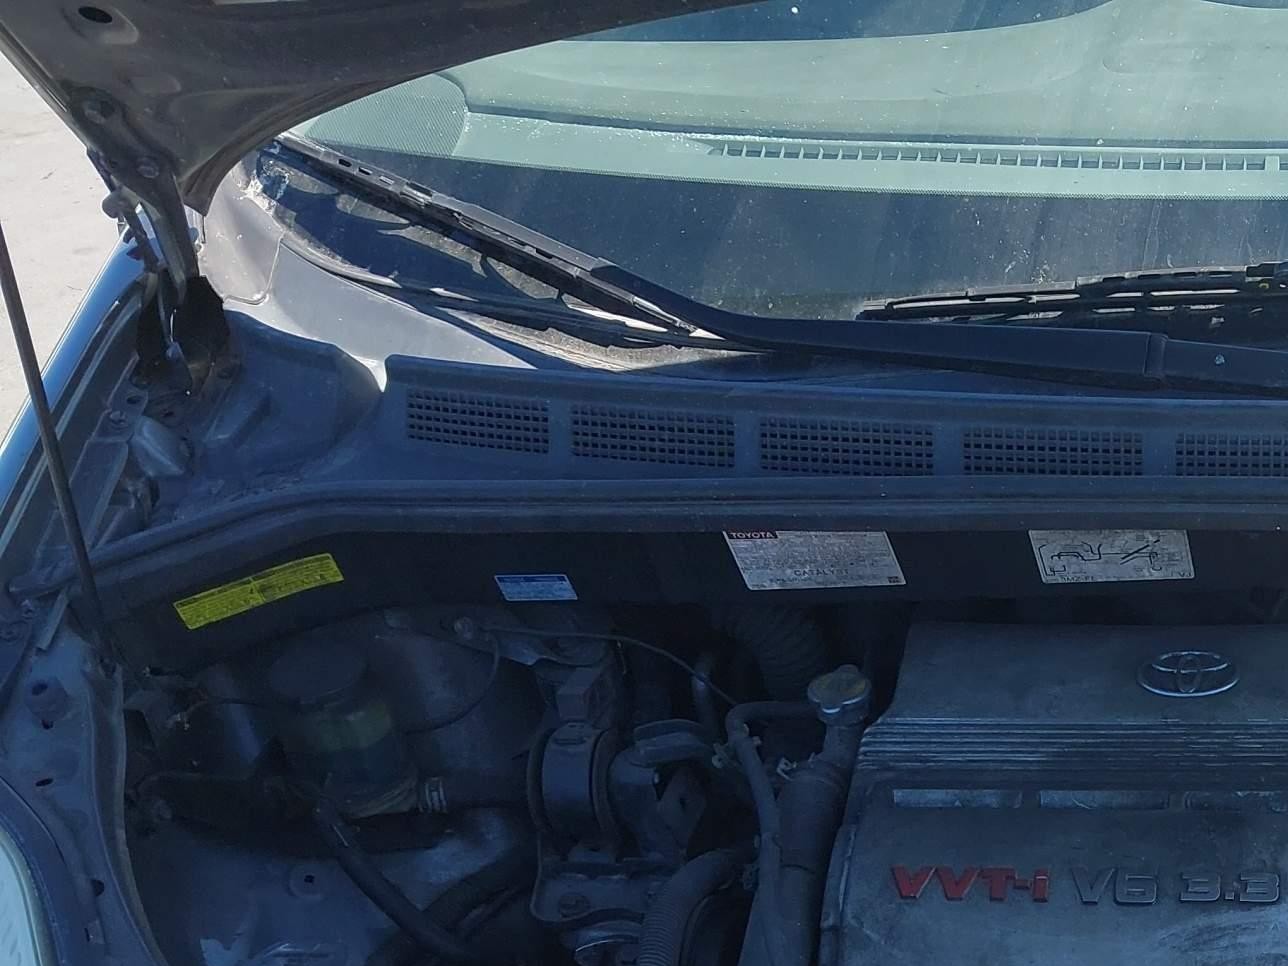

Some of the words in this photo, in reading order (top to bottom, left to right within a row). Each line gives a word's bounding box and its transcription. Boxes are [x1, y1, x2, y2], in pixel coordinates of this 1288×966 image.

[891, 866, 1049, 903] VVT-i
[1070, 867, 1157, 904] V6
[1179, 871, 1281, 904] 3.3
